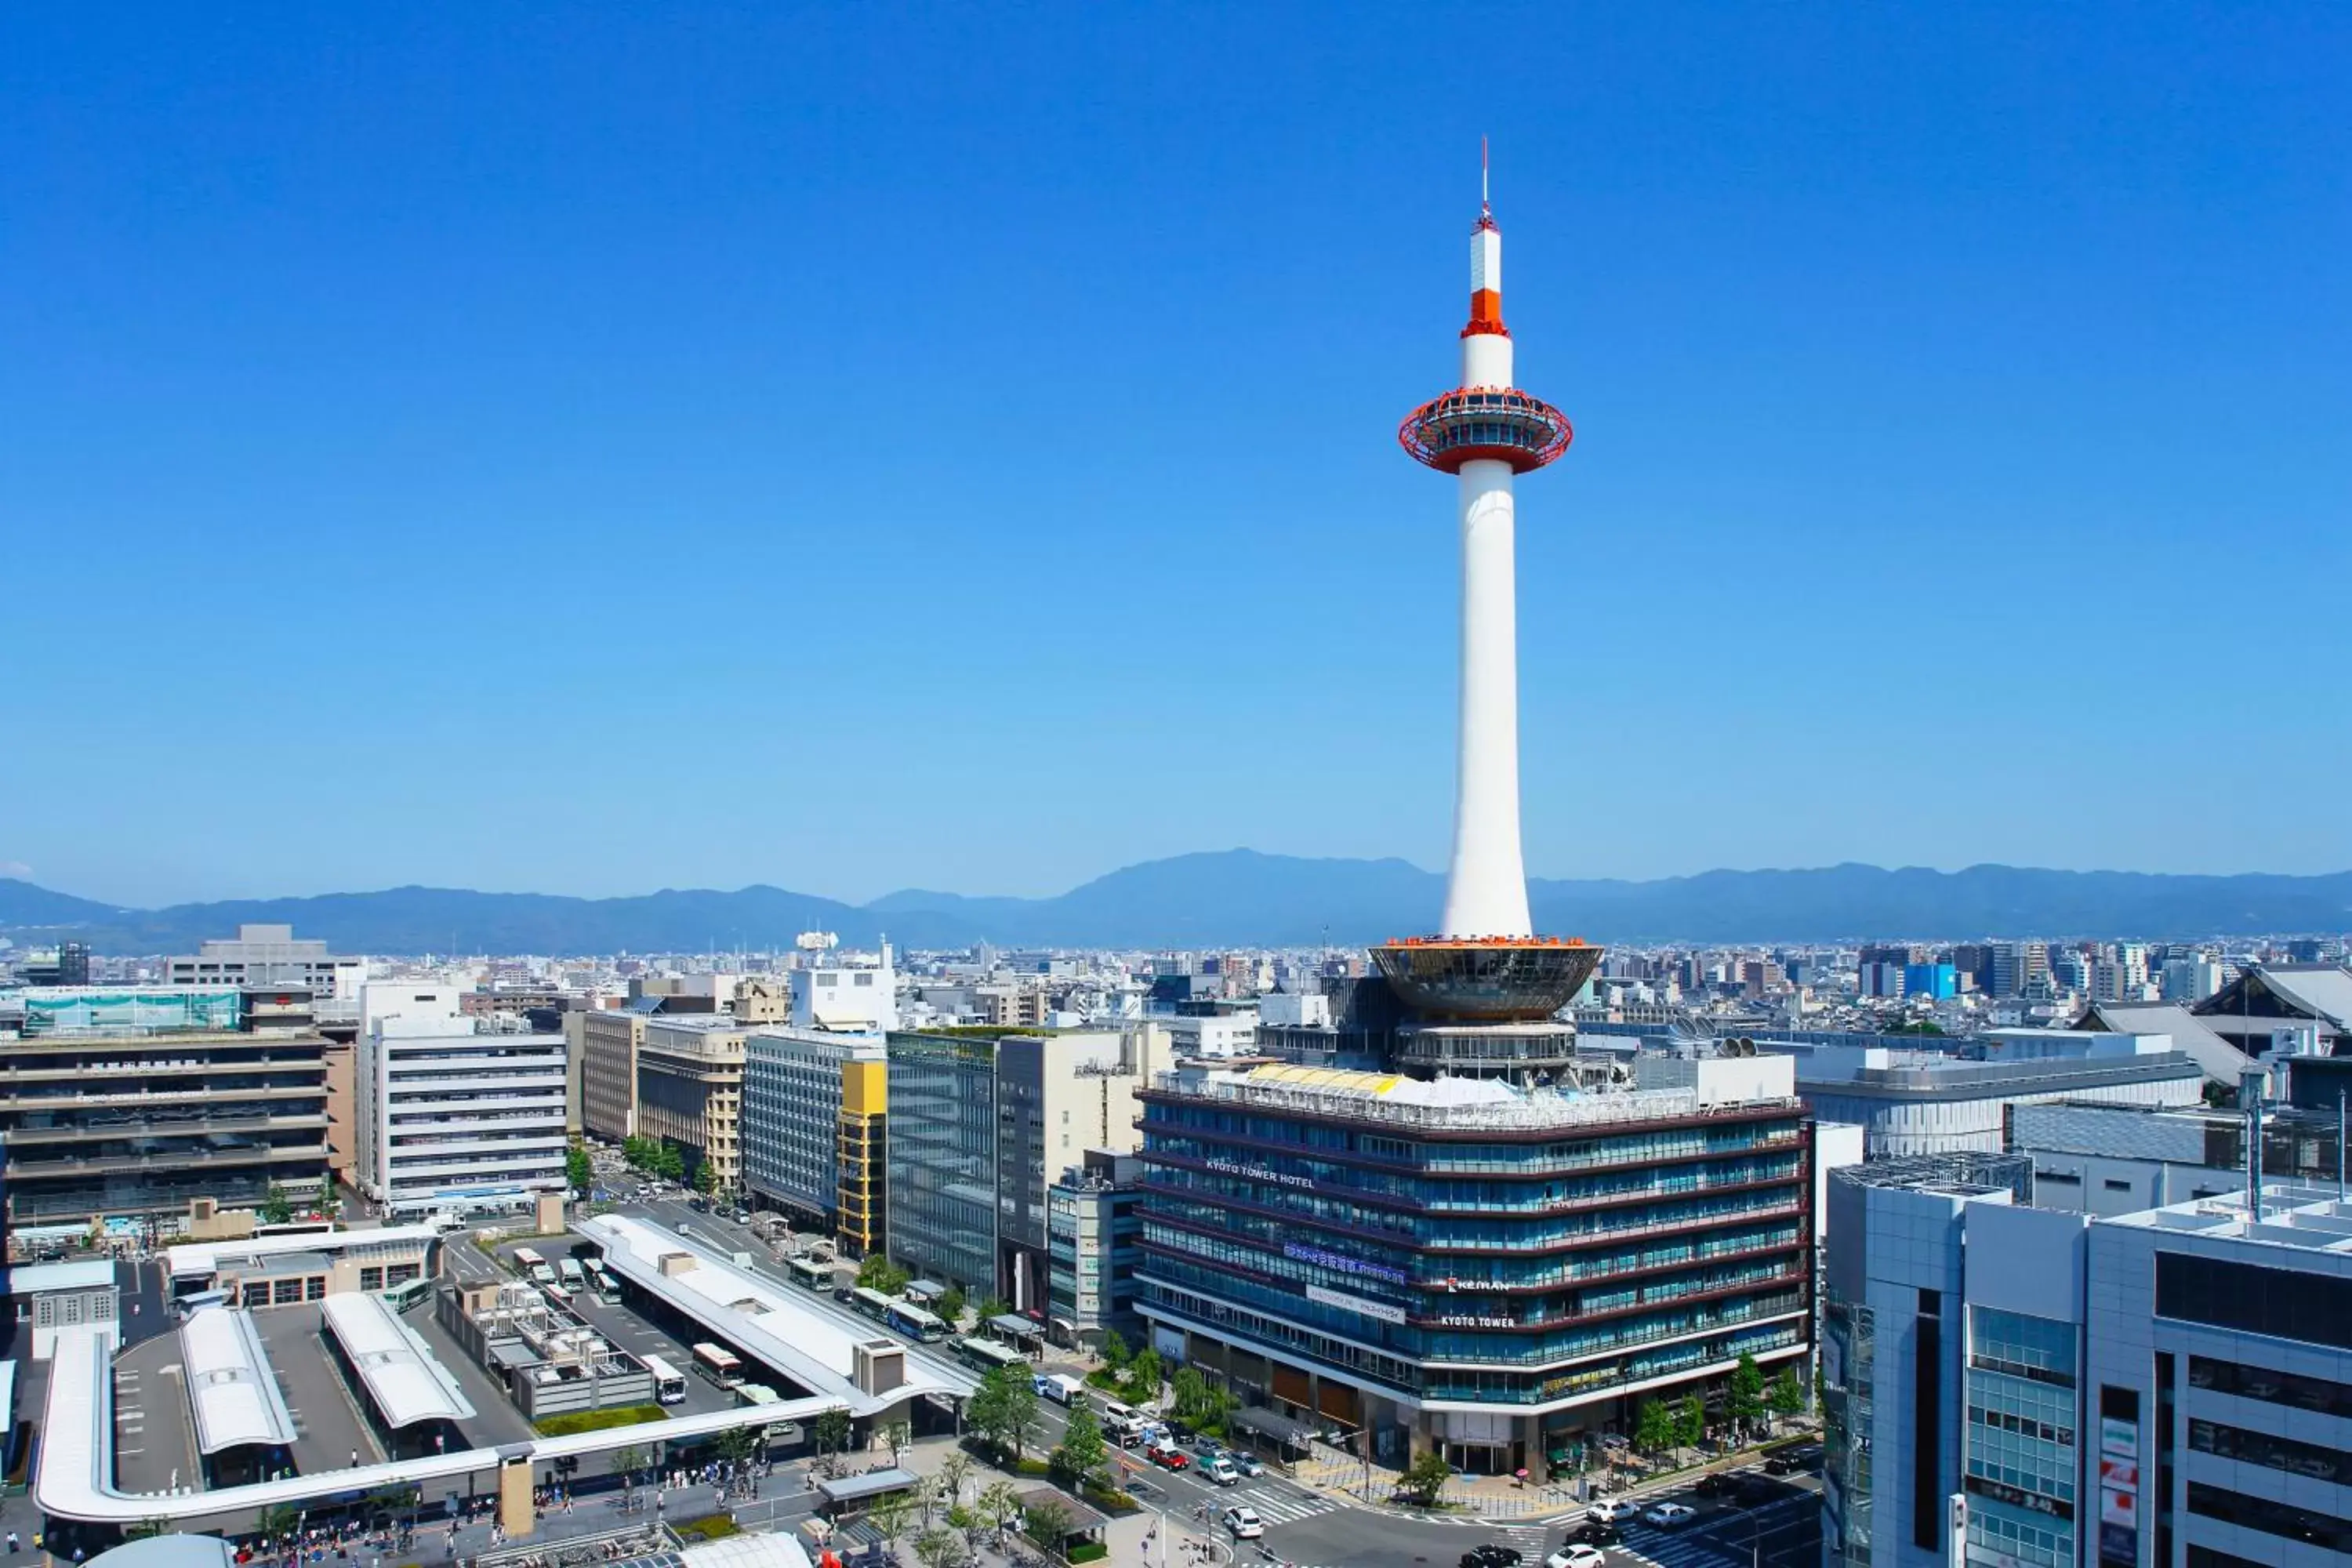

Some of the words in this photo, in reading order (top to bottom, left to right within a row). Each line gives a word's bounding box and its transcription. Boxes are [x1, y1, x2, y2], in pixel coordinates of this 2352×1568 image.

[1207, 1160, 1239, 1174] KYOTO
[1241, 1166, 1277, 1181] TOWER
[1280, 1174, 1315, 1189] HOTEL
[1442, 1316, 1475, 1327] KYOTO
[1479, 1318, 1515, 1328] TOWER
